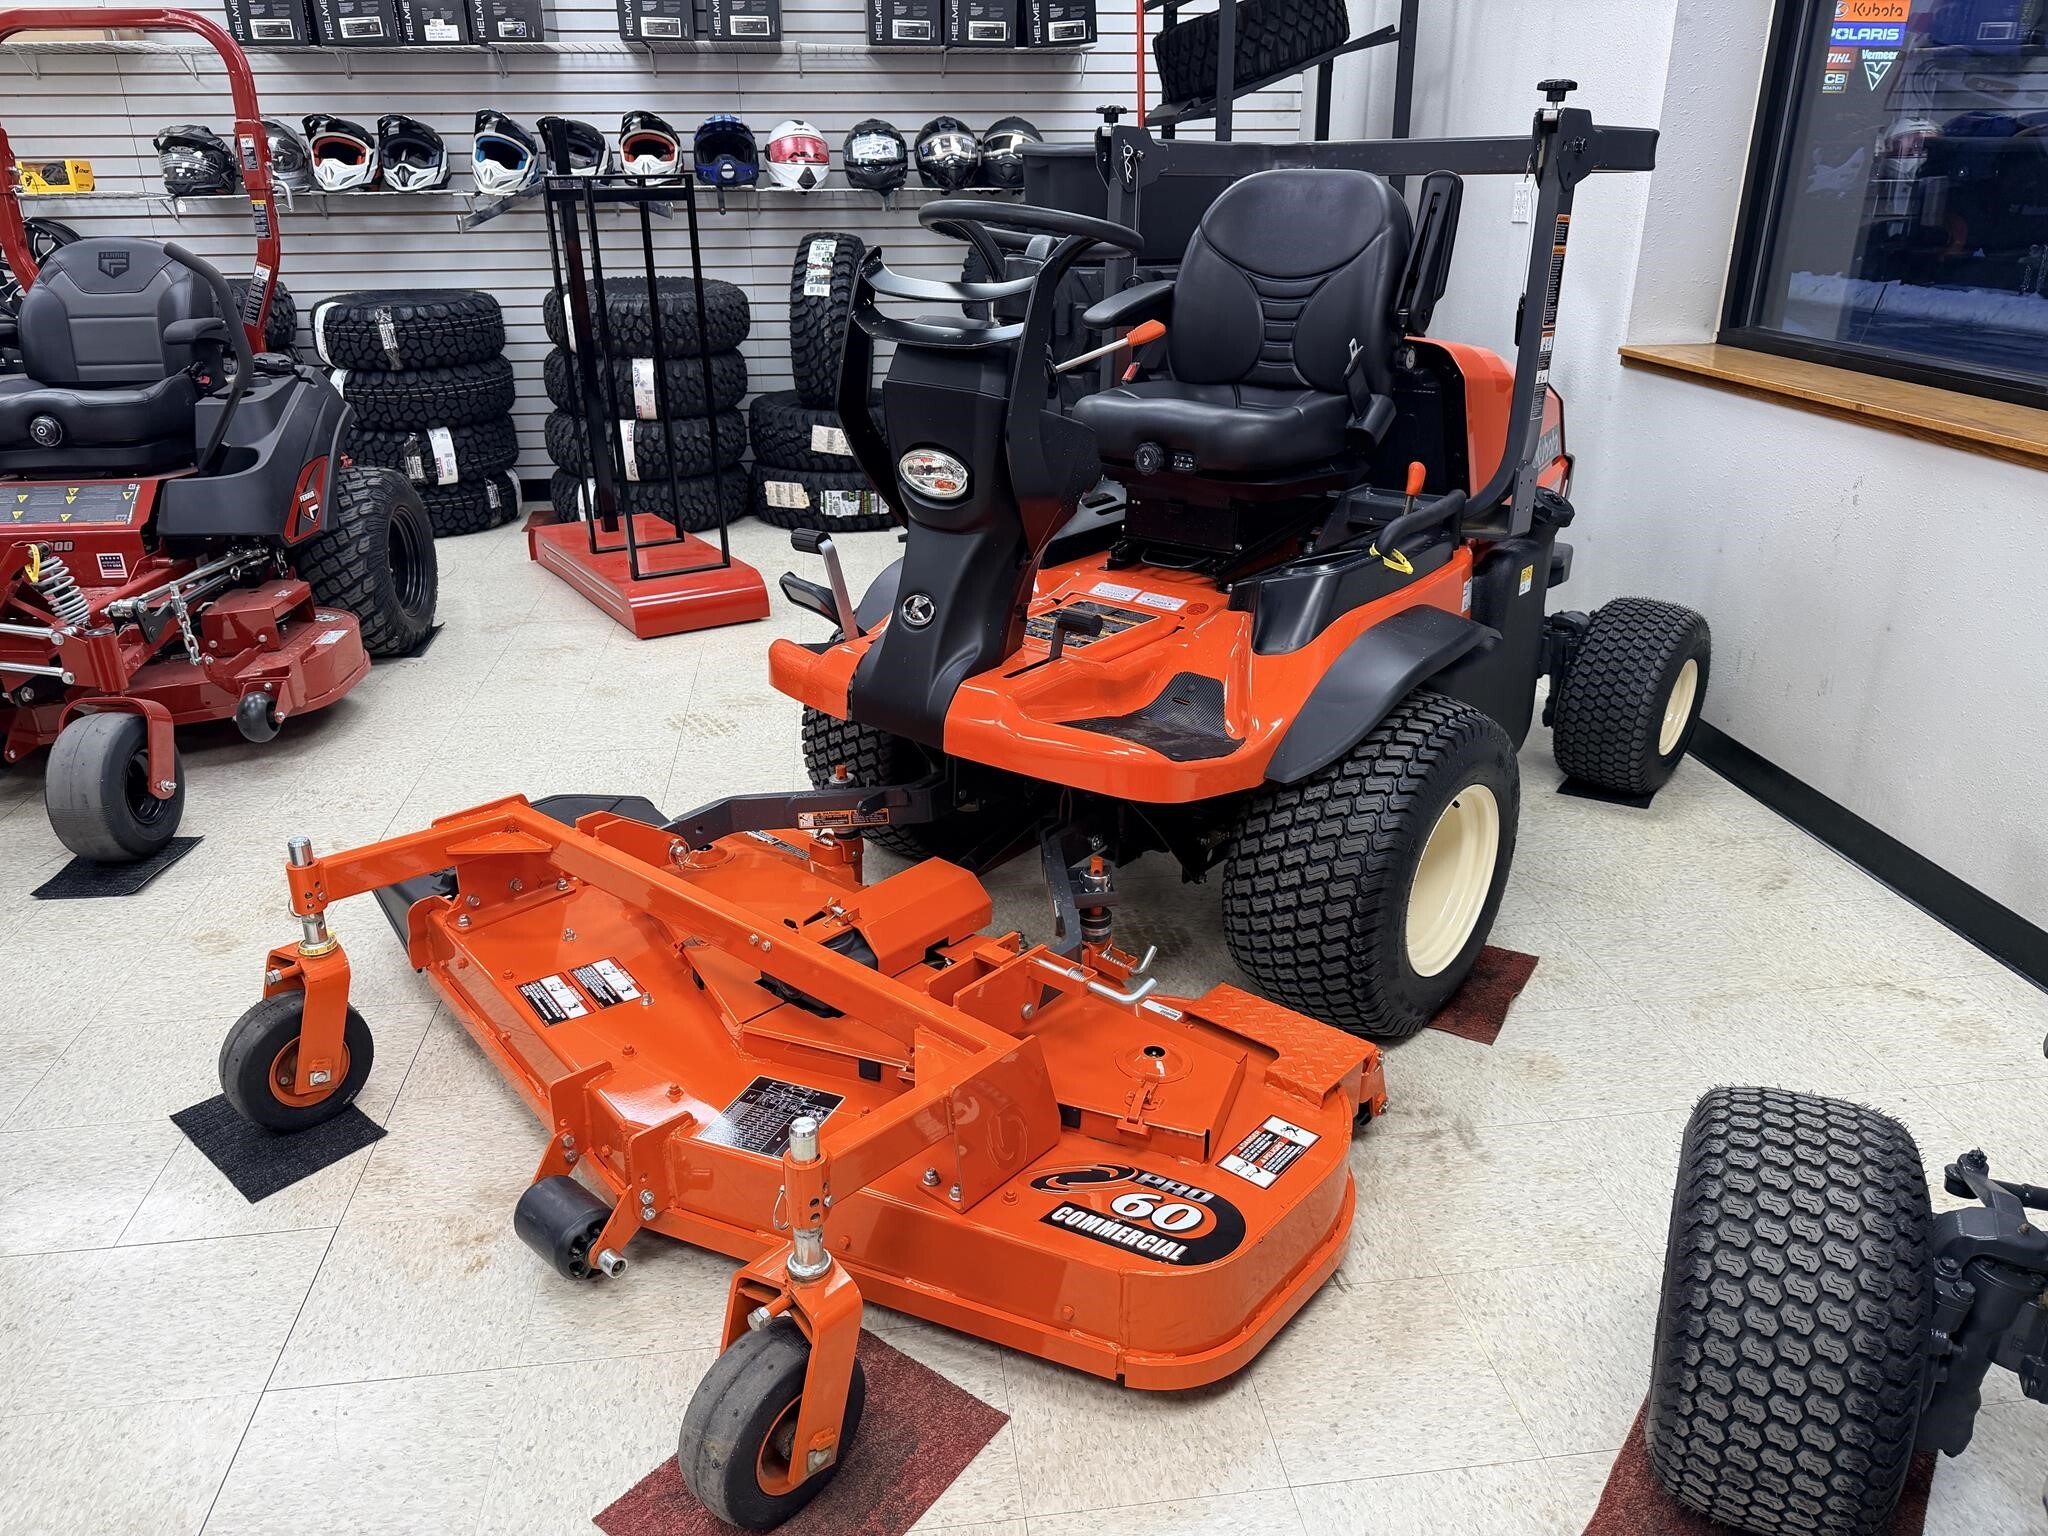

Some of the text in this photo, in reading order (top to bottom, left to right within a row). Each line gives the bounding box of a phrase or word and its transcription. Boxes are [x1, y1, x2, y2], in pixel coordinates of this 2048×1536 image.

[1853, 3, 1904, 17] Kubota
[1862, 49, 1899, 60] Vermeer
[299, 490, 315, 503] FERRIS
[1134, 1173, 1216, 1204] PRO
[1110, 1192, 1205, 1233] 60
[1051, 1205, 1190, 1262] COMMERCIAL
